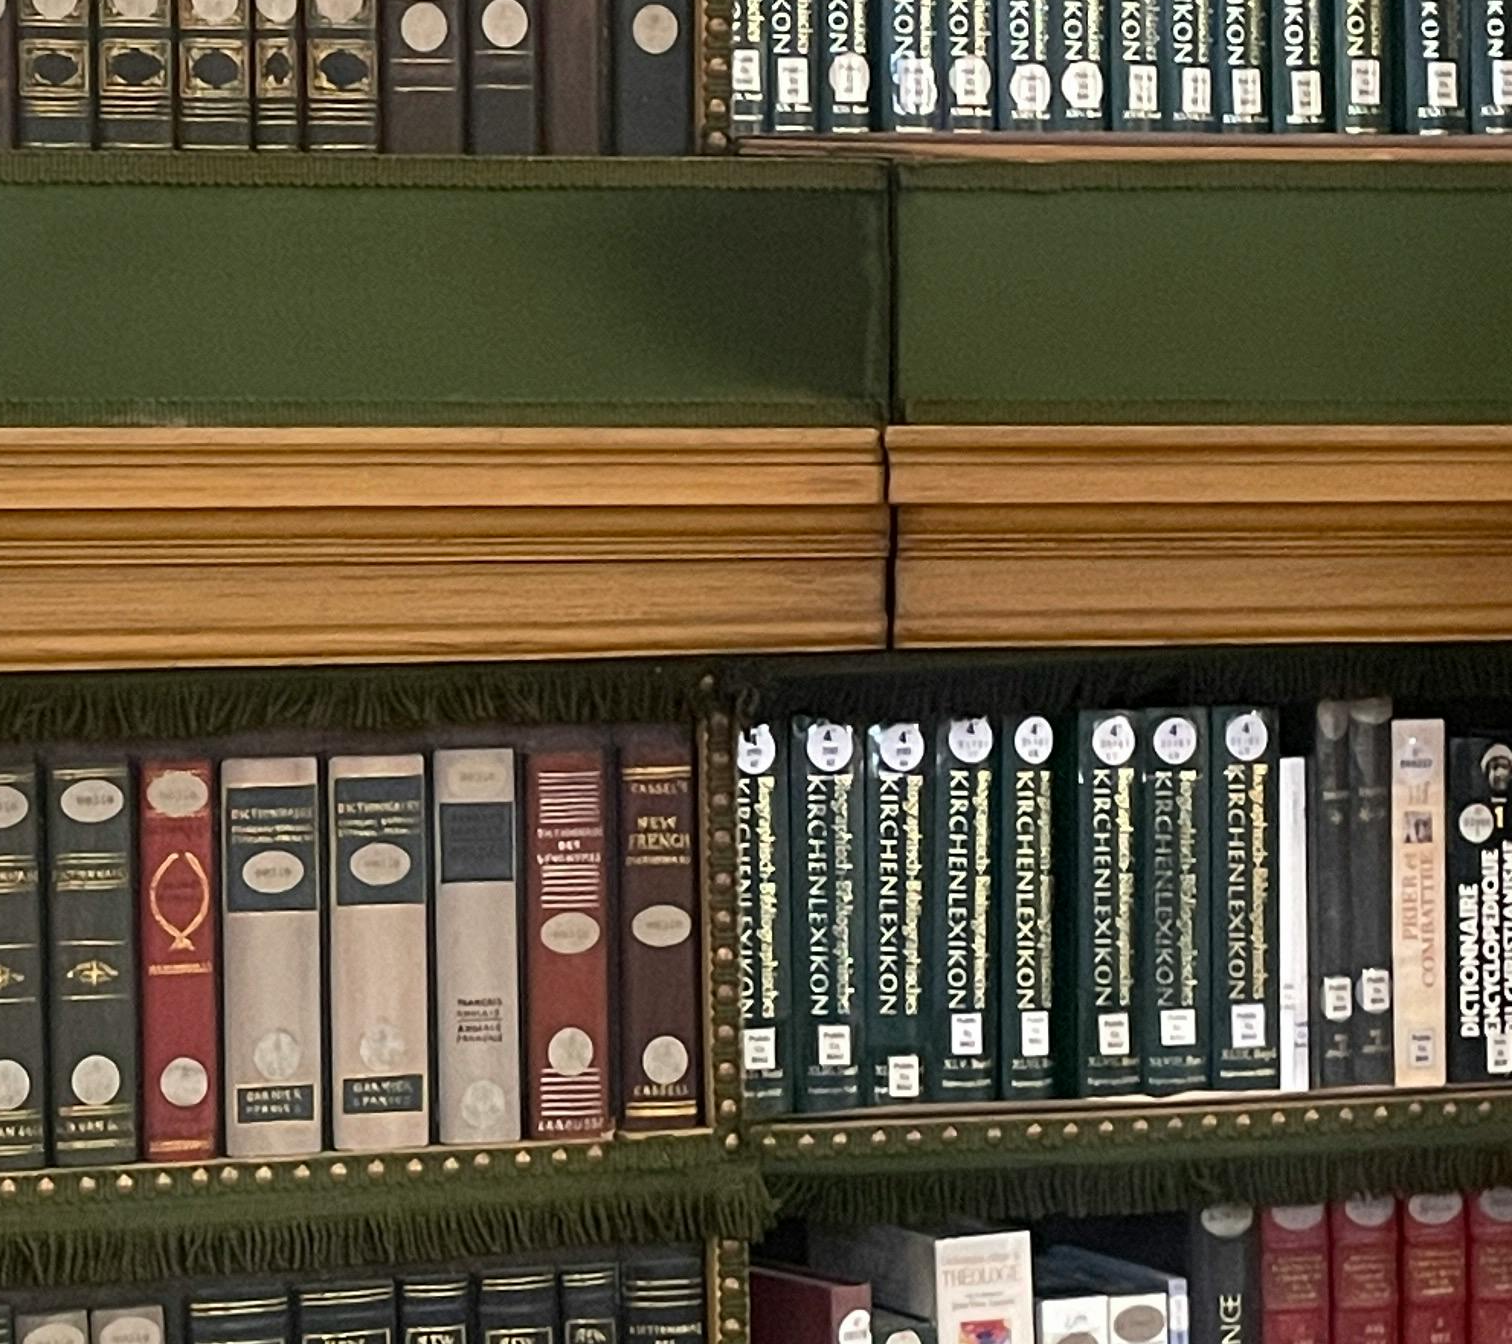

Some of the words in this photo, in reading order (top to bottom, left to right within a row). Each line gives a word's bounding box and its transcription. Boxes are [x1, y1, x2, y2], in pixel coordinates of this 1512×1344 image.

[806, 774, 829, 1015] KIRCHENLEXIKON
[879, 774, 900, 1015] KIRCHENLEXIKON
[948, 770, 968, 1009] KIRCHENLEXIKON
[1016, 771, 1036, 1009] KIRCHENLEXIKON
[1092, 768, 1113, 1007] KIRCHENLEXIKON
[1154, 770, 1174, 1008] KIRCHENLEXIKON
[1224, 764, 1246, 999] KIRCHENLEXIKON
[1459, 883, 1480, 1038] DICTIONNAIRE
